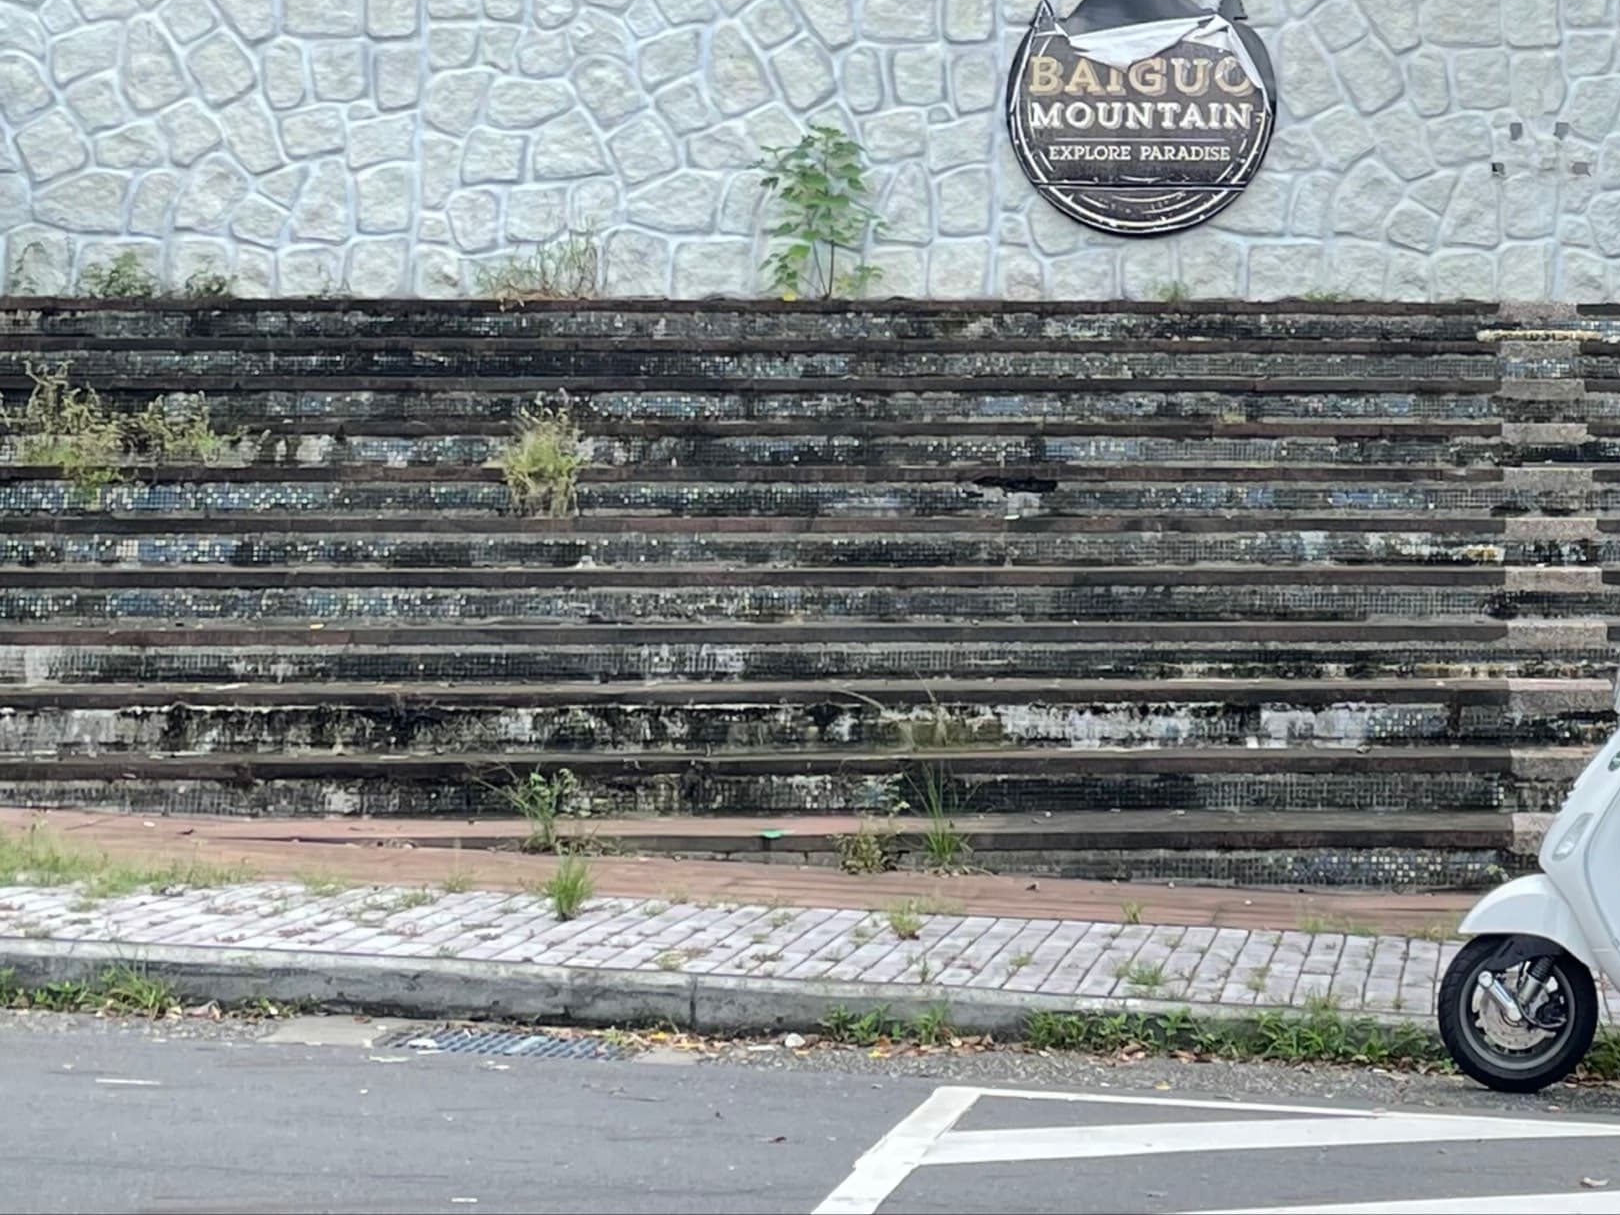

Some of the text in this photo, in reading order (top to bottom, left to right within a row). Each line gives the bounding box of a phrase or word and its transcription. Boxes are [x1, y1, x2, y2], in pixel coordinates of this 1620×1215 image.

[1028, 55, 1254, 96] BAIGUO
[1031, 101, 1254, 130] MOUNTAIN
[1049, 145, 1231, 161] EXPLORE PARADISE
